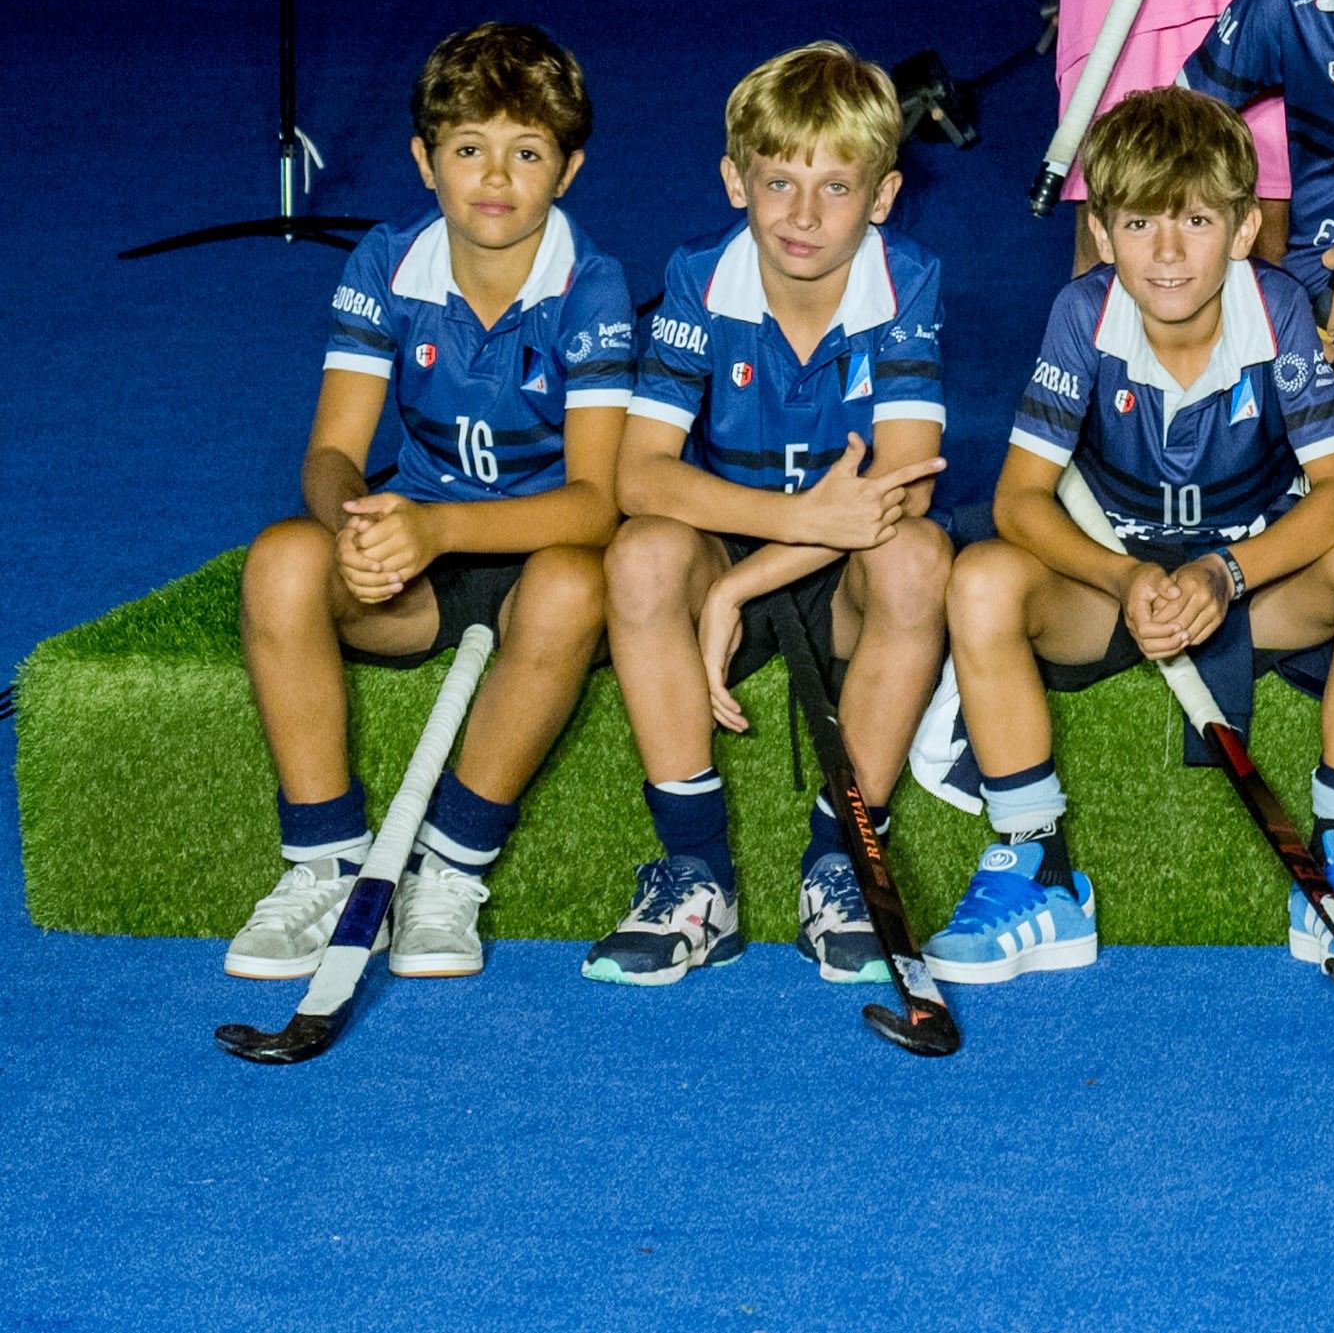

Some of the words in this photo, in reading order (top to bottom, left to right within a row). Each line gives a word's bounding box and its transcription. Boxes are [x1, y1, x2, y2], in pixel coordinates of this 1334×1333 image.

[455, 415, 499, 484] 16
[784, 442, 810, 495] 5
[1159, 480, 1202, 527] 10
[847, 786, 882, 861] RITUAL
